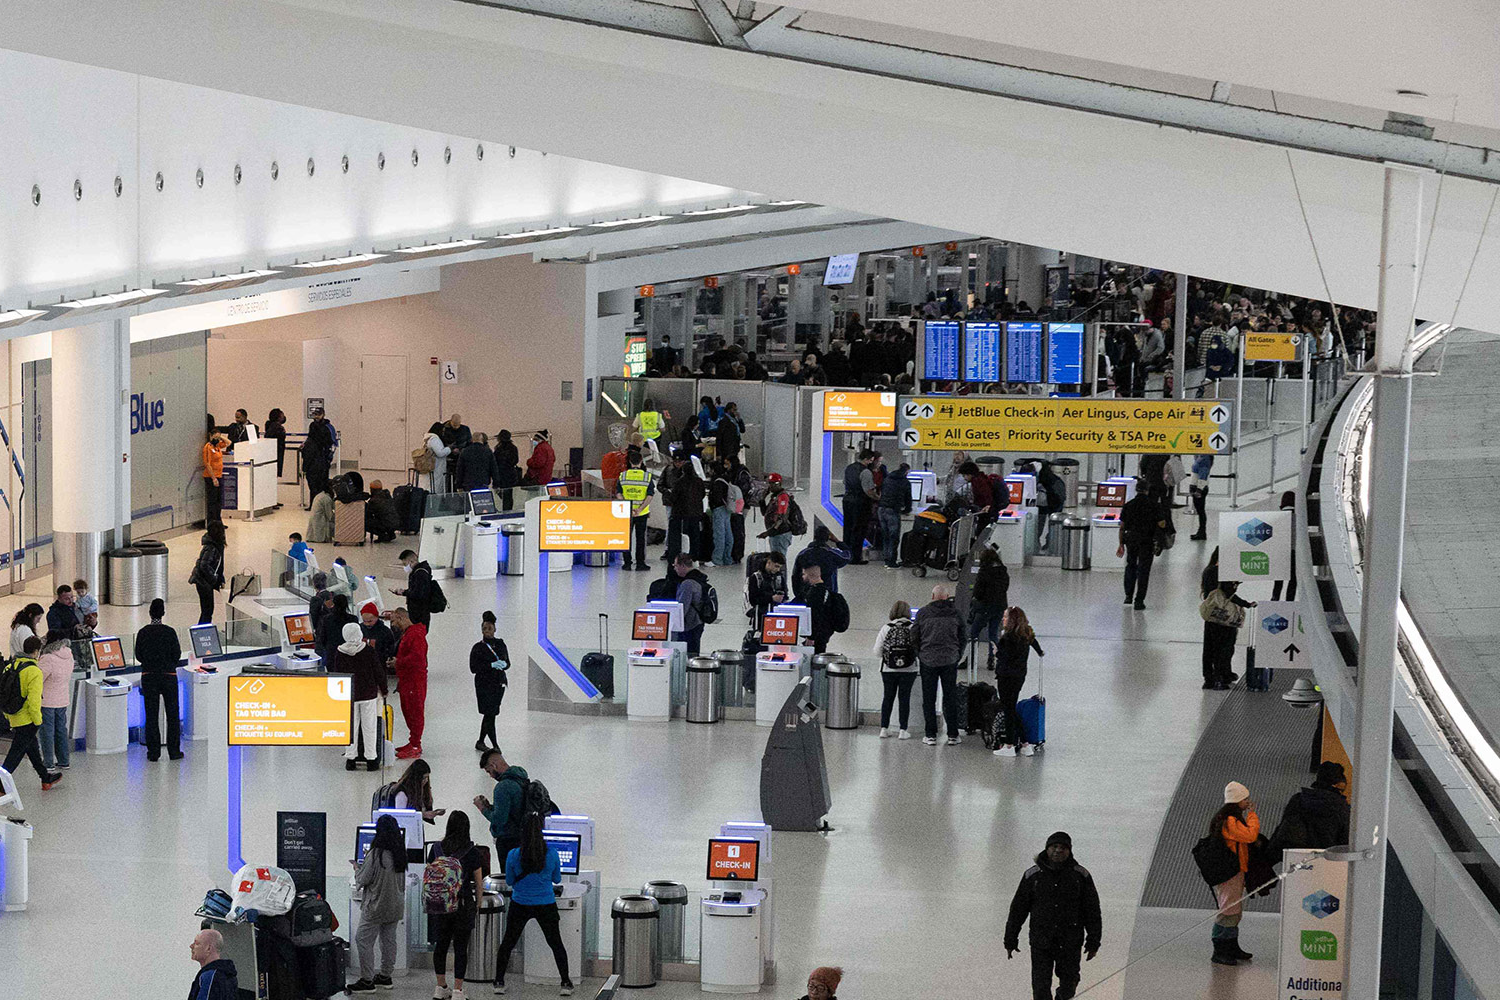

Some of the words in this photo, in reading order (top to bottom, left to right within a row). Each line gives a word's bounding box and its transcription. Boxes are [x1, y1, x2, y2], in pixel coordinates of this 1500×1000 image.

[958, 406, 1001, 418] JetBlue
[1004, 406, 1055, 418] Check-in
[1062, 408, 1083, 419] Aer
[1087, 408, 1130, 421] Lingus,
[1133, 408, 1163, 421] Cape
[1167, 409, 1185, 419] Air
[944, 428, 961, 440] All
[965, 429, 1000, 440] Gates
[1008, 429, 1051, 443] Priority
[1055, 430, 1103, 444] Security
[1107, 431, 1116, 441] &
[1120, 431, 1143, 441] TSA
[1147, 431, 1166, 442] Pre
[1242, 561, 1268, 570] MINT
[337, 680, 344, 693] 1
[322, 729, 345, 739] jetBlue
[715, 861, 751, 869] CHECK-IN
[1303, 944, 1334, 953] MINT
